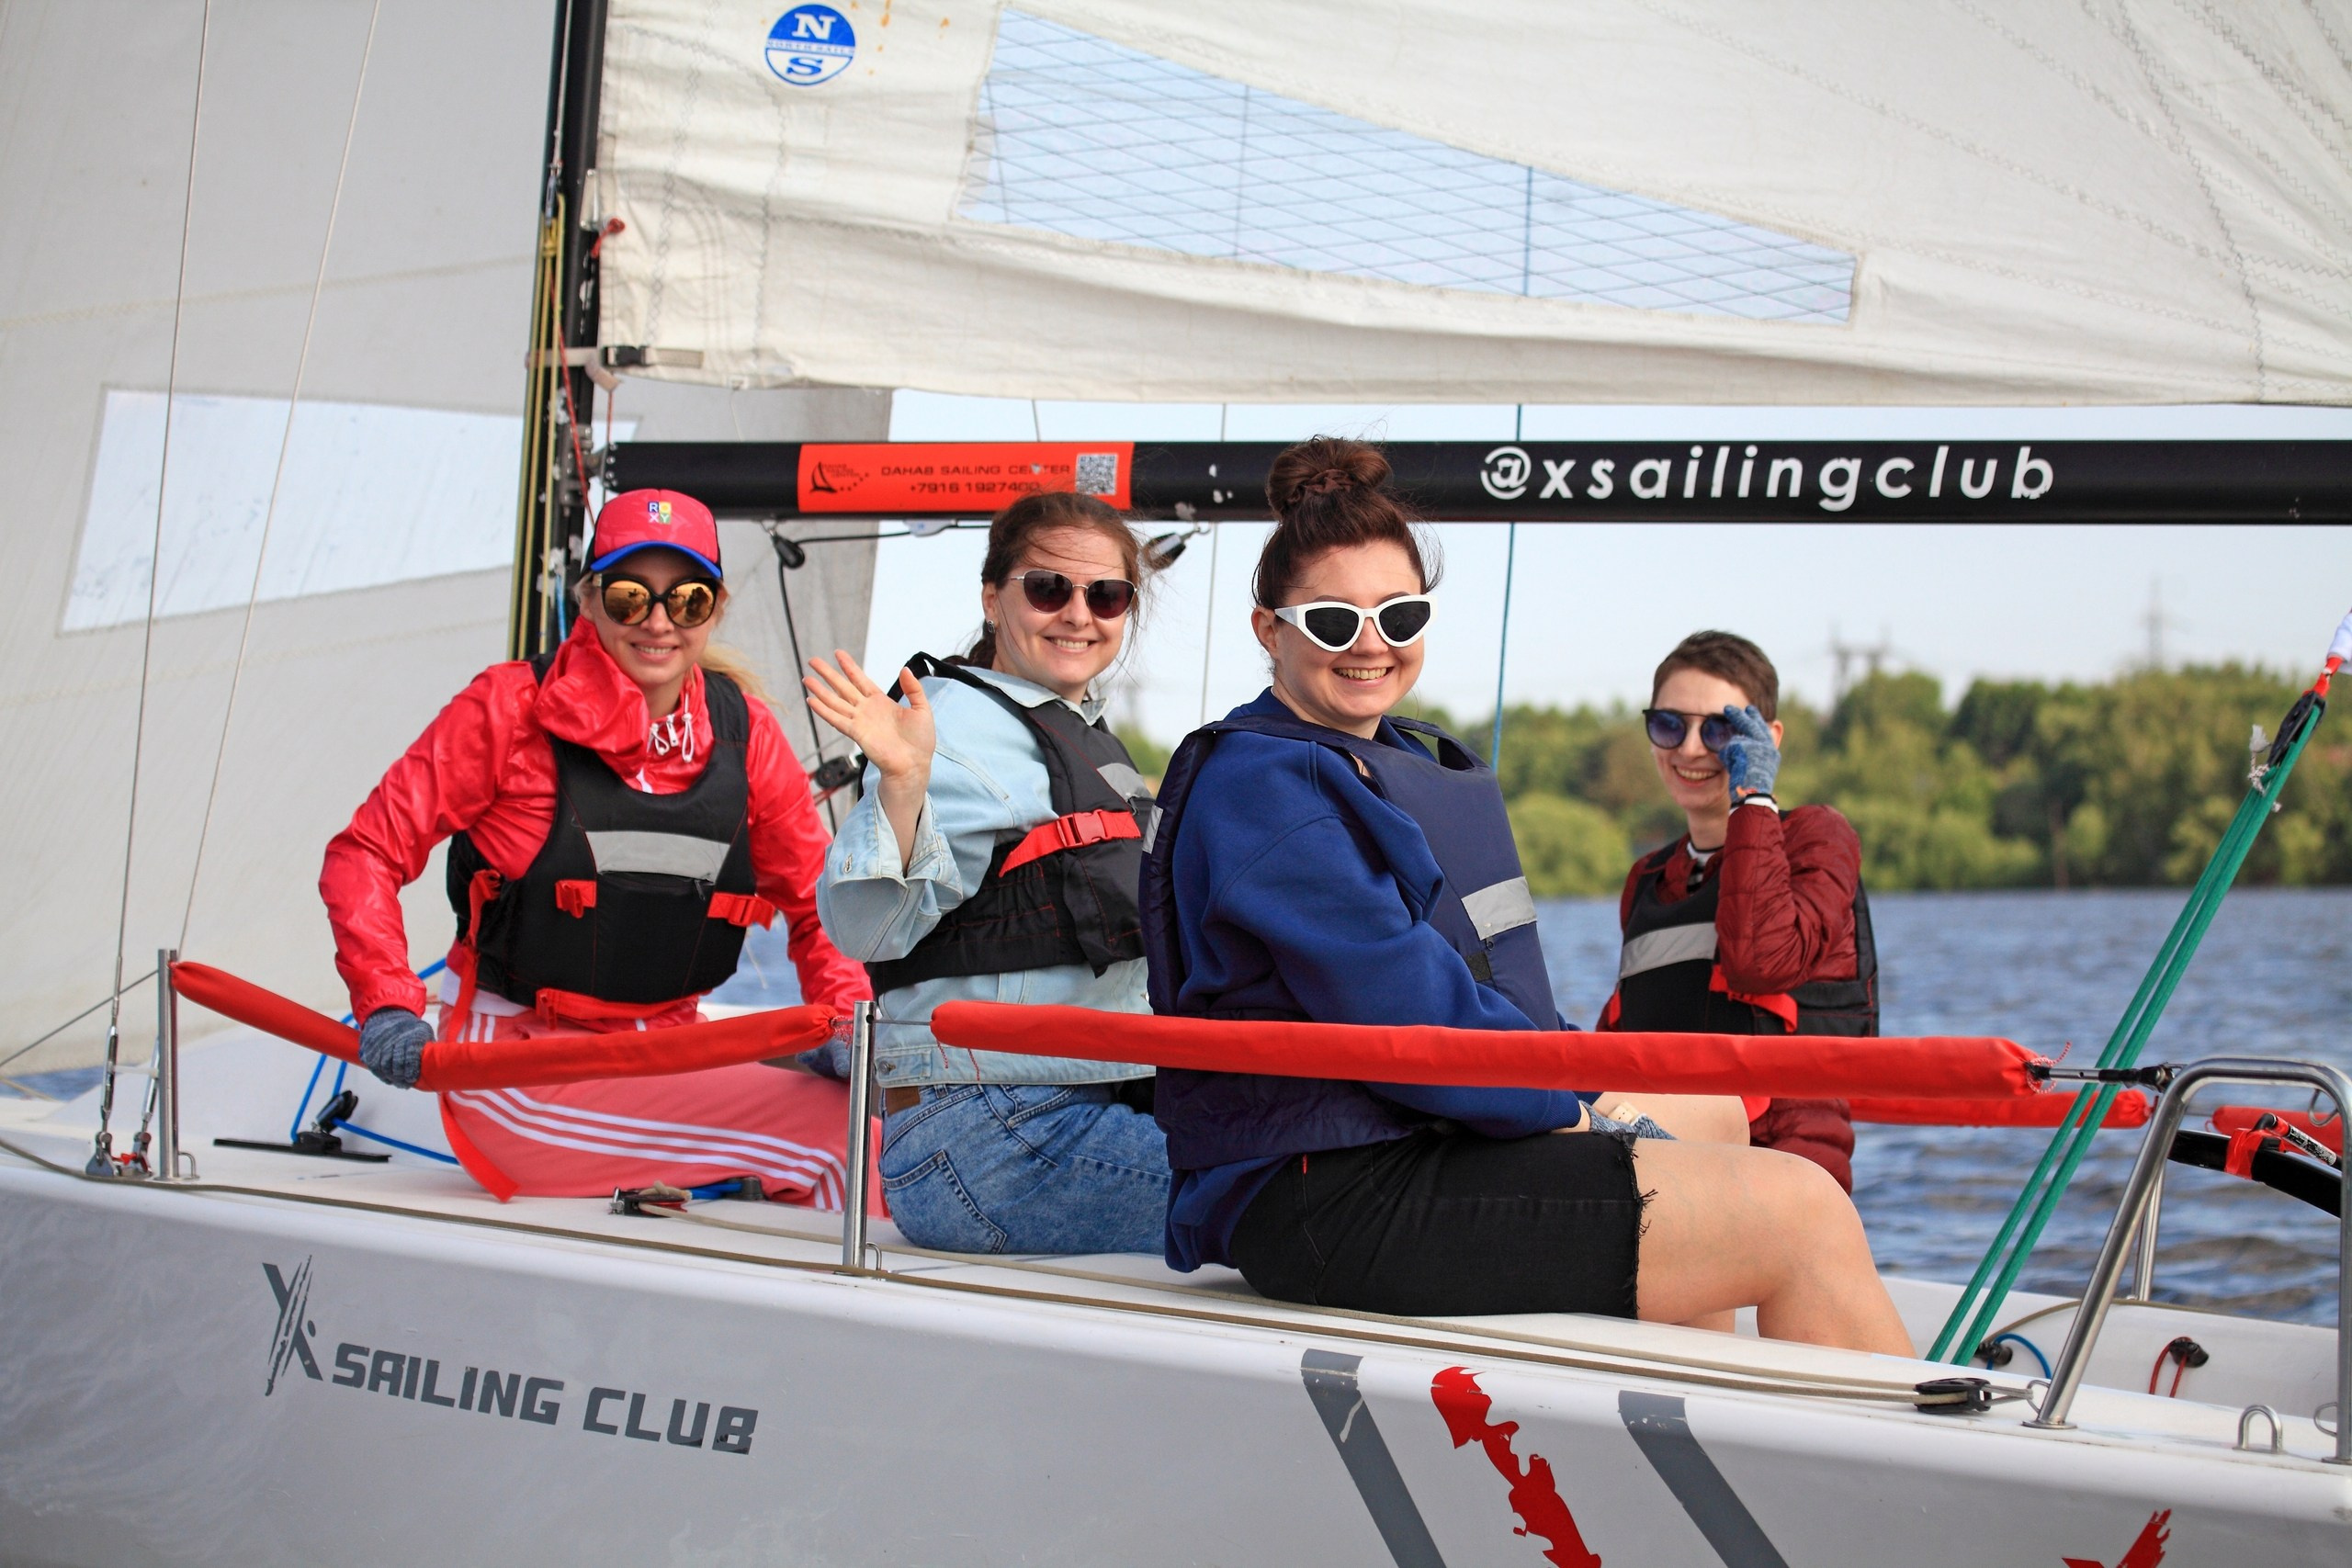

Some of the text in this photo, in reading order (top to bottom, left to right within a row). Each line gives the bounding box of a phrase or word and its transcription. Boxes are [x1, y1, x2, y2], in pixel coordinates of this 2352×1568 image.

[791, 12, 837, 40] N
[786, 55, 823, 76] S
[881, 465, 934, 477] DAHAB
[940, 465, 1001, 476] SAILING
[1480, 445, 2054, 513] @xsailingclub
[332, 1341, 565, 1426] SAILING
[582, 1386, 760, 1456] CLUB
